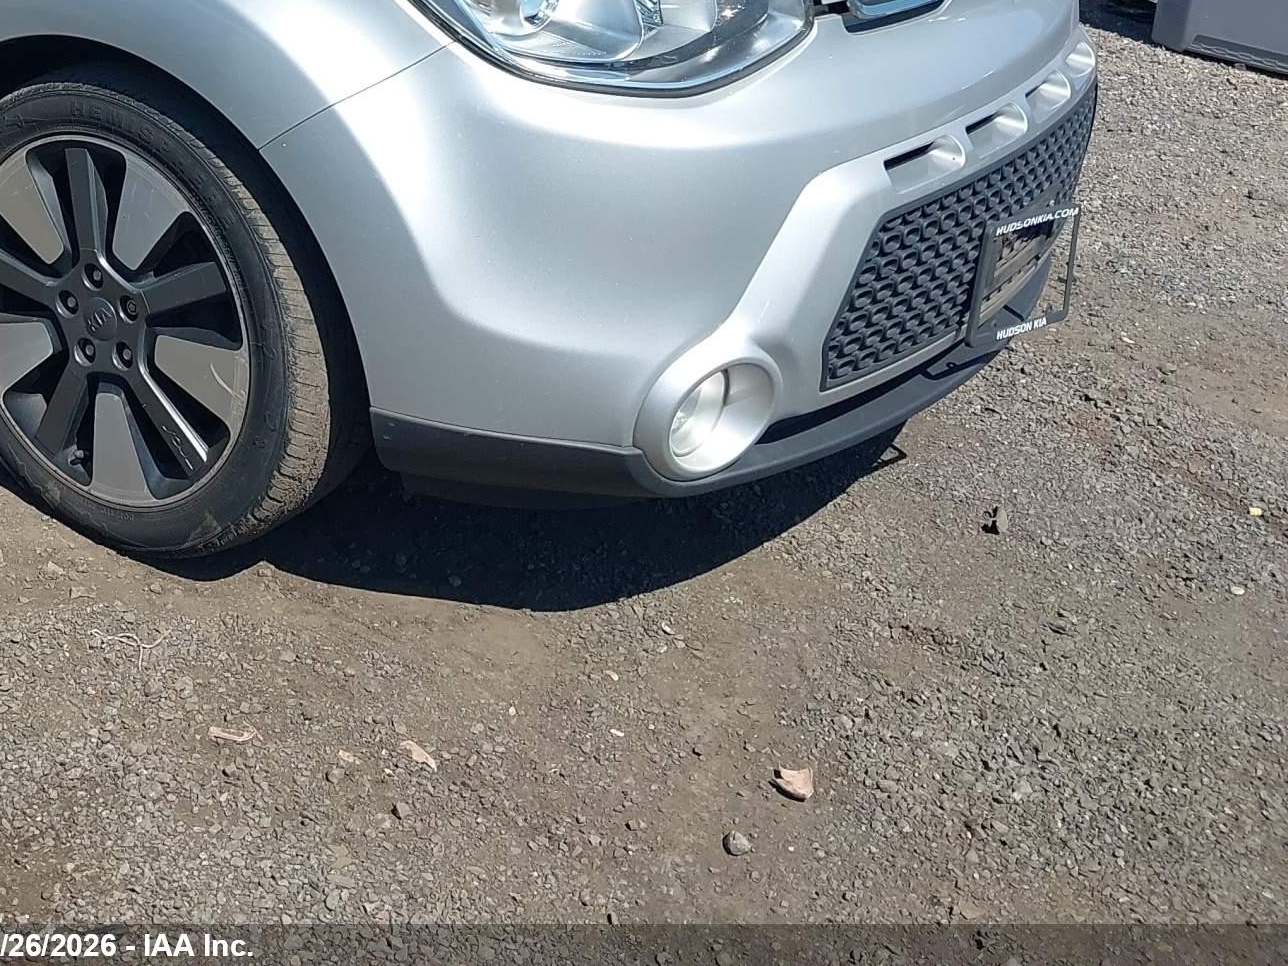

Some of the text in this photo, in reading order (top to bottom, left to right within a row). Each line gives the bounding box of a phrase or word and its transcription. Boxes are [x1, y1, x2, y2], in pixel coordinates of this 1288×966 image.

[995, 207, 1080, 236] HUDSONKIA.COM
[995, 317, 1048, 340] HUDSON KIA
